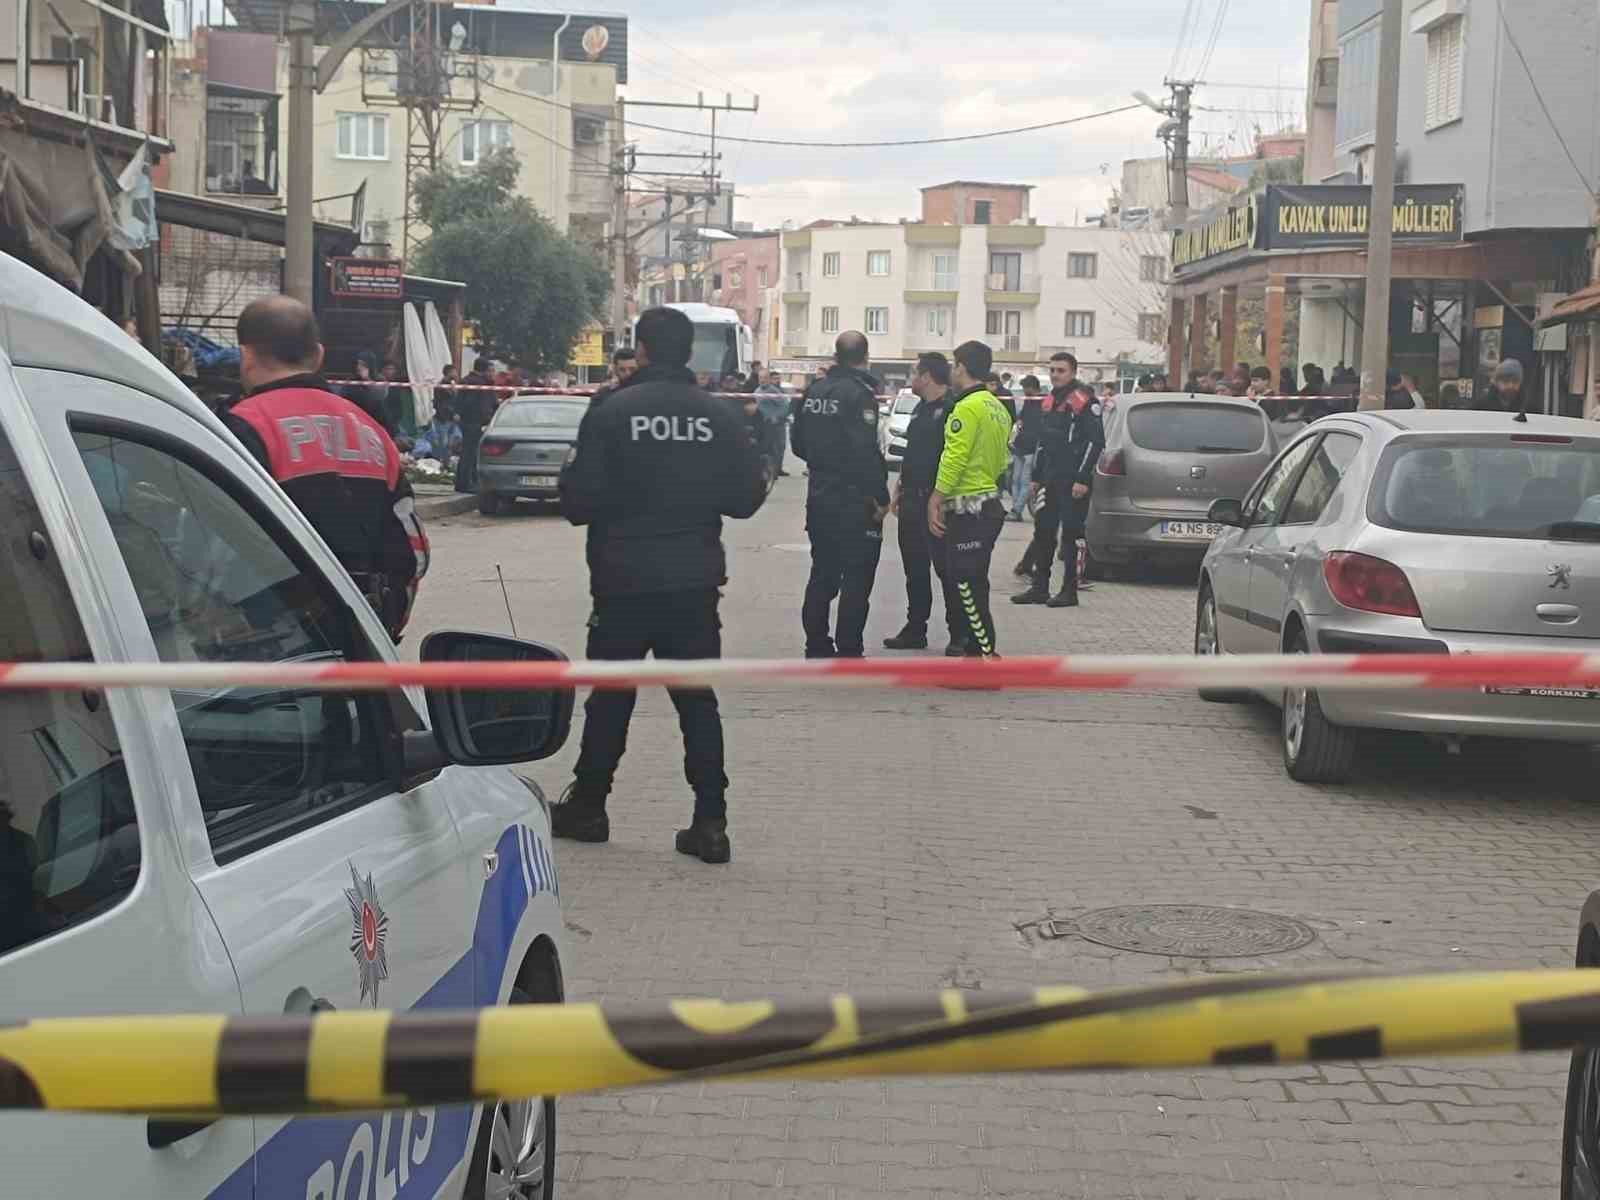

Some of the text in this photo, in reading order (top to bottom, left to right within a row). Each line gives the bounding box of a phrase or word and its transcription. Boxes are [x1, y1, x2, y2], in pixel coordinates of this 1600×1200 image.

[1279, 198, 1455, 233] KAVAK UNLU MÜLLERİ
[1169, 523, 1183, 534] 41
[1186, 523, 1203, 534] NS
